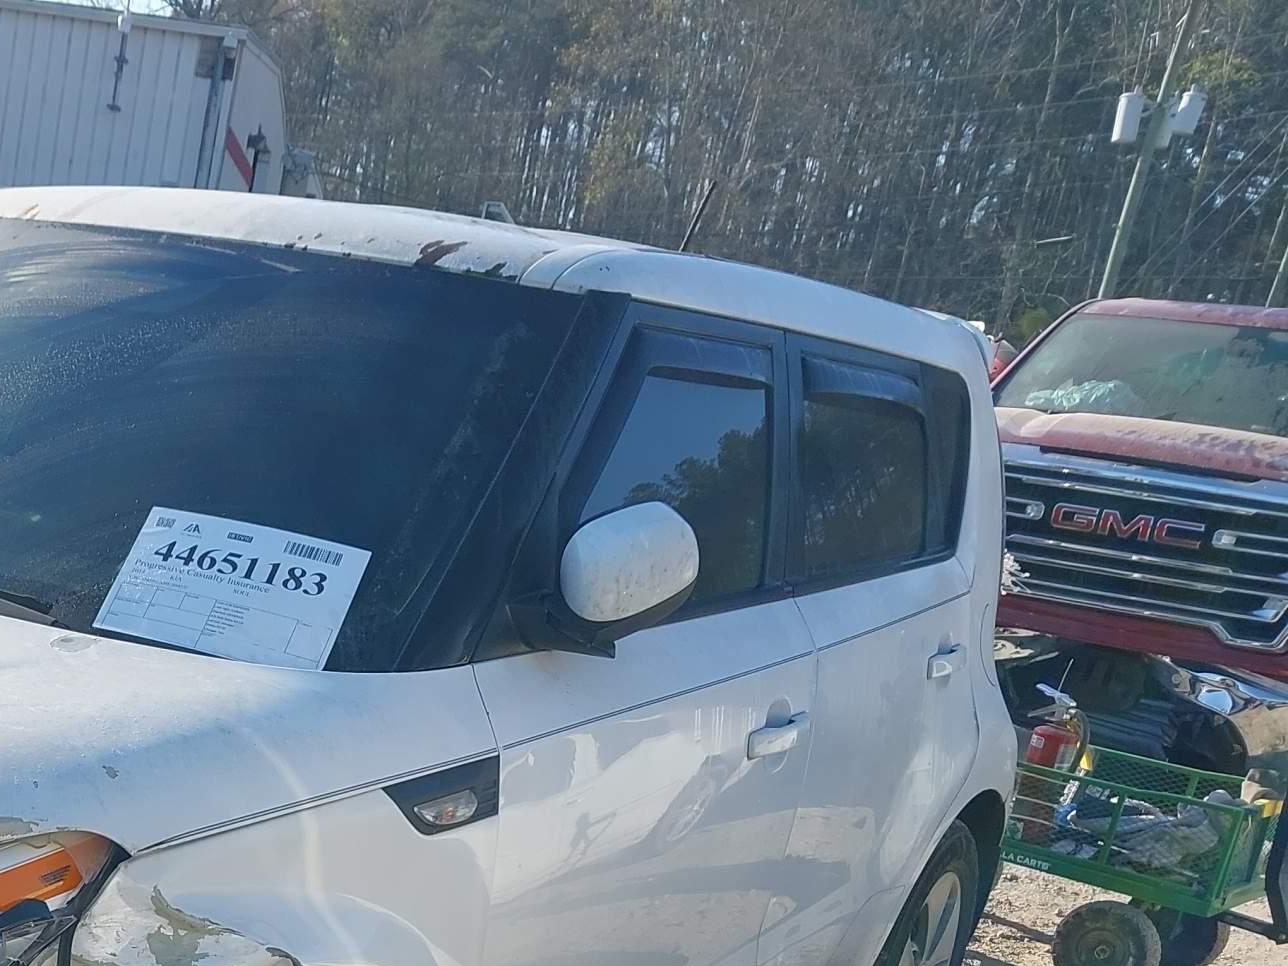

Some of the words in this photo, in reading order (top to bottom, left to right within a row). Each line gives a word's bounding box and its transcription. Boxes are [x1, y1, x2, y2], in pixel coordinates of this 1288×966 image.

[1051, 503, 1205, 549] GMC
[135, 558, 185, 576] Progressive
[187, 567, 224, 583] Casualty
[227, 577, 271, 594] Insurance
[154, 540, 328, 596] 44651183
